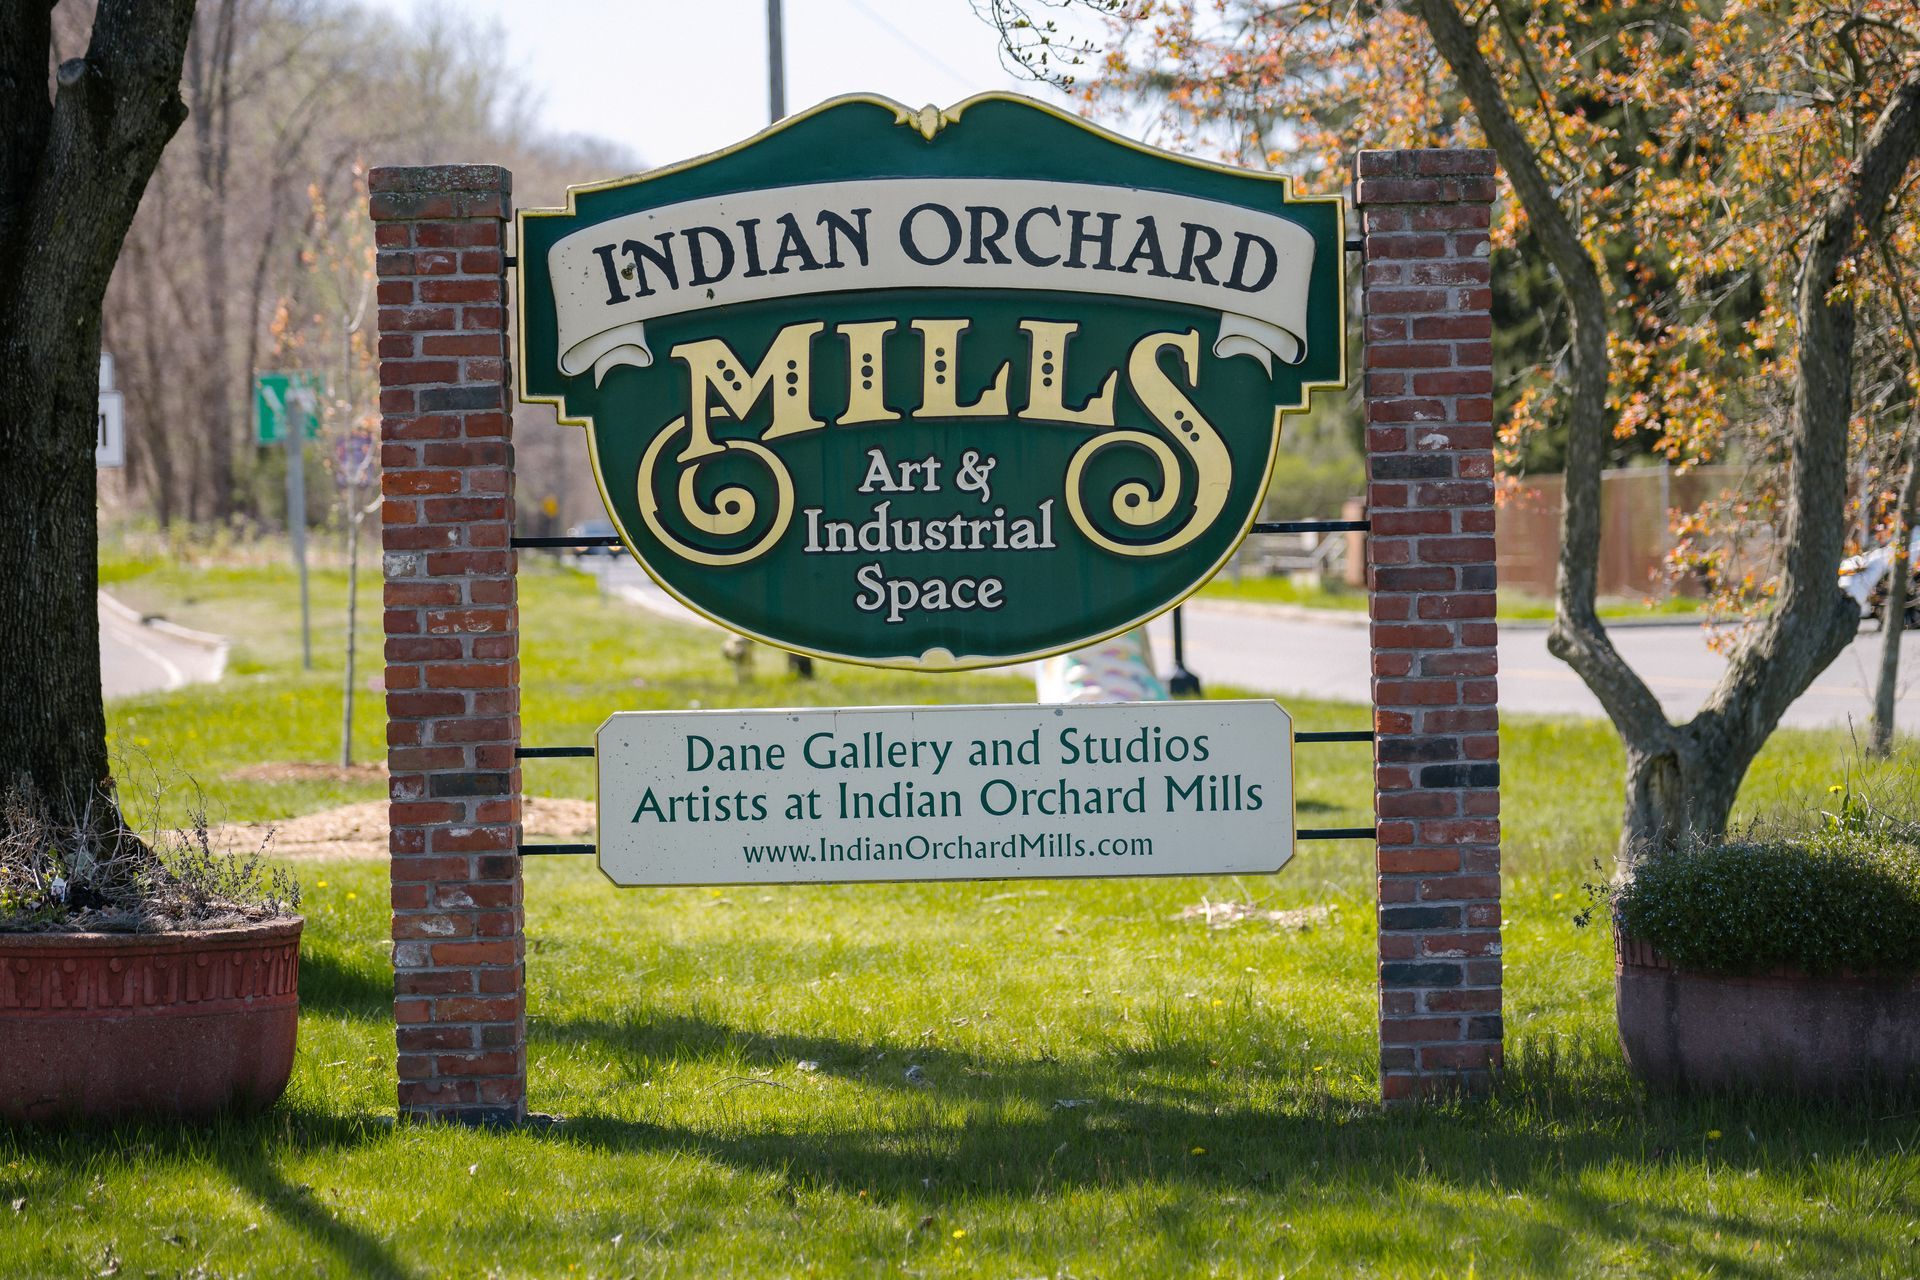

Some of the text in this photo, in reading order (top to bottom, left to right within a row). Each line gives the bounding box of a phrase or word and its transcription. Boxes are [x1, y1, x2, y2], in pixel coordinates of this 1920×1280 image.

[591, 202, 1279, 306] INDIAN ORCHARD
[637, 318, 1233, 566] MILLS
[858, 448, 997, 504] Art &
[803, 499, 1057, 553] Industrial
[855, 562, 1004, 623] Space
[685, 725, 1210, 776] Dane Gallery and Studios
[630, 773, 1264, 825] Artists at Indian Orchard Mills
[742, 831, 1154, 865] www.IndianOrchardMills.com
